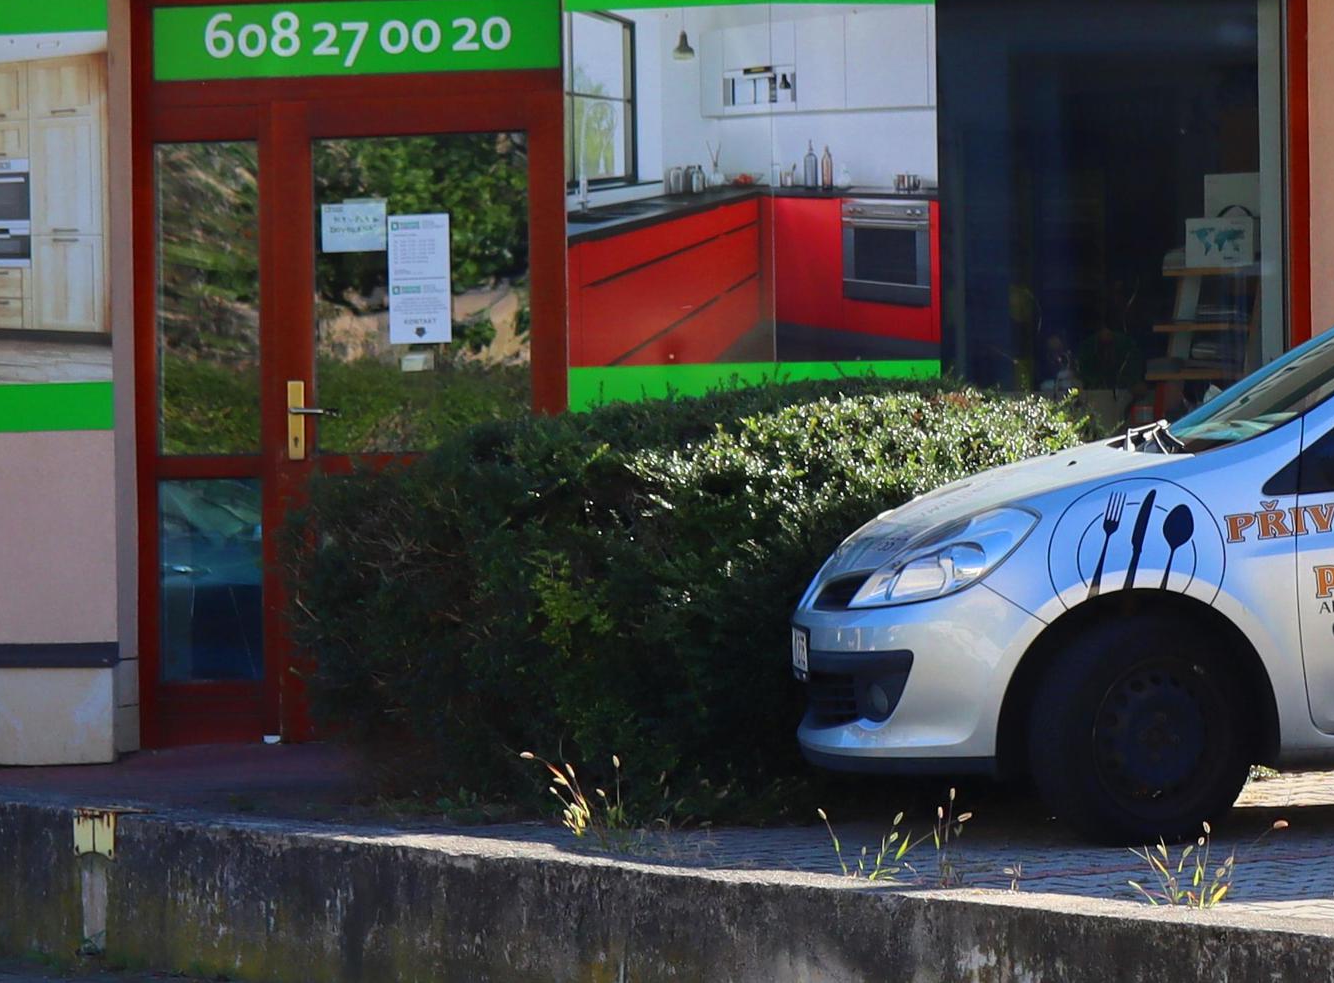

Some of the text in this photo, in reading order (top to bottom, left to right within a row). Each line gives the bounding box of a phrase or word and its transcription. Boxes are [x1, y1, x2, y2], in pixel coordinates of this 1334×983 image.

[204, 11, 512, 68] 608 27 00 20
